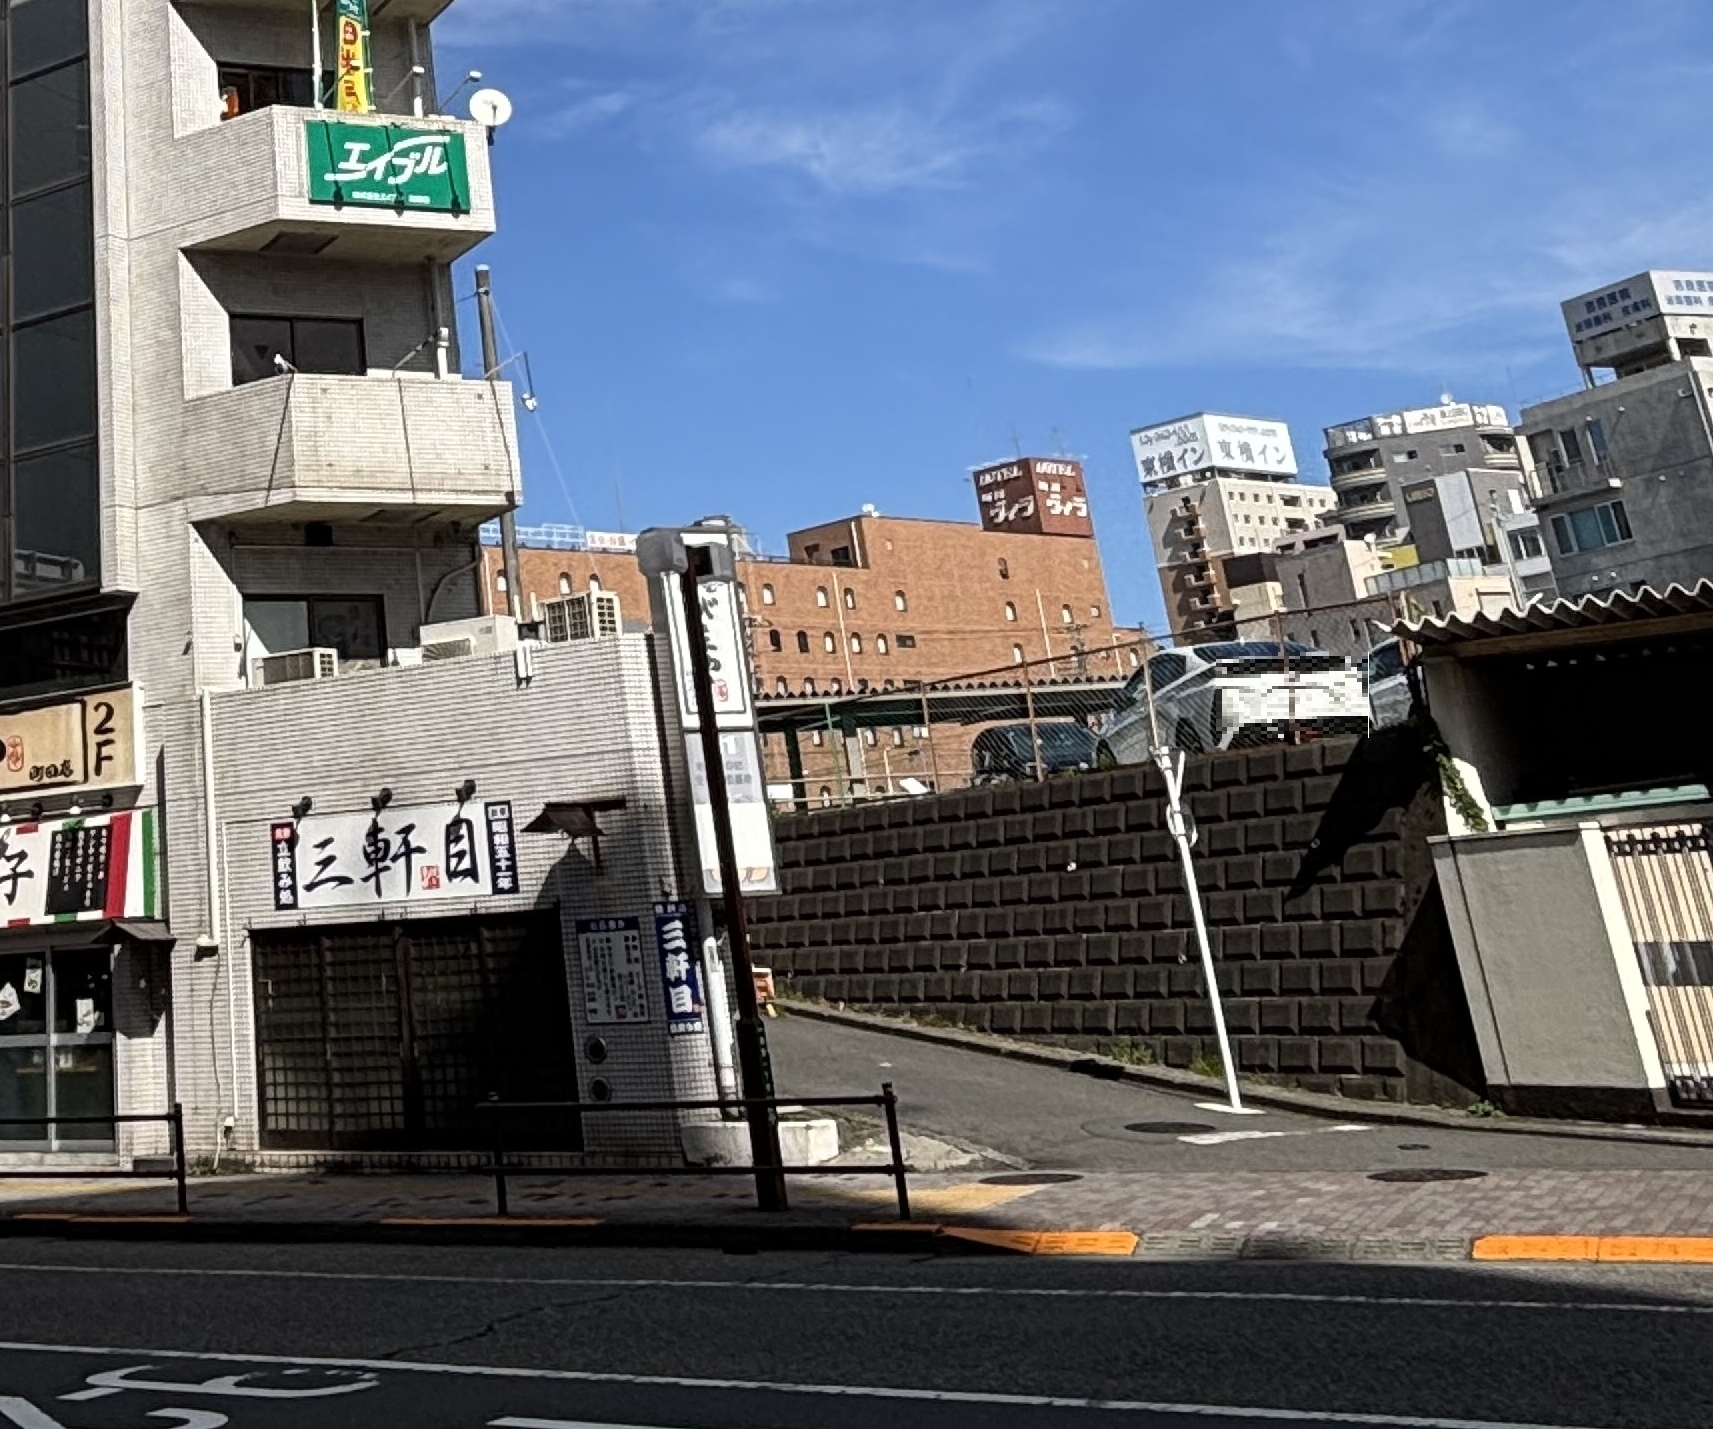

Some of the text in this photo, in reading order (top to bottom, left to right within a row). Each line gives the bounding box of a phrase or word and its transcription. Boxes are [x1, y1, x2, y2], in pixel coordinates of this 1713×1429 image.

[324, 135, 451, 185] エイブル
[1141, 445, 1205, 479] 東横イン
[1217, 439, 1287, 466] 東横イン
[93, 702, 115, 776] 2F
[302, 818, 480, 898] 三軒目
[661, 919, 693, 1014] 三軒目
